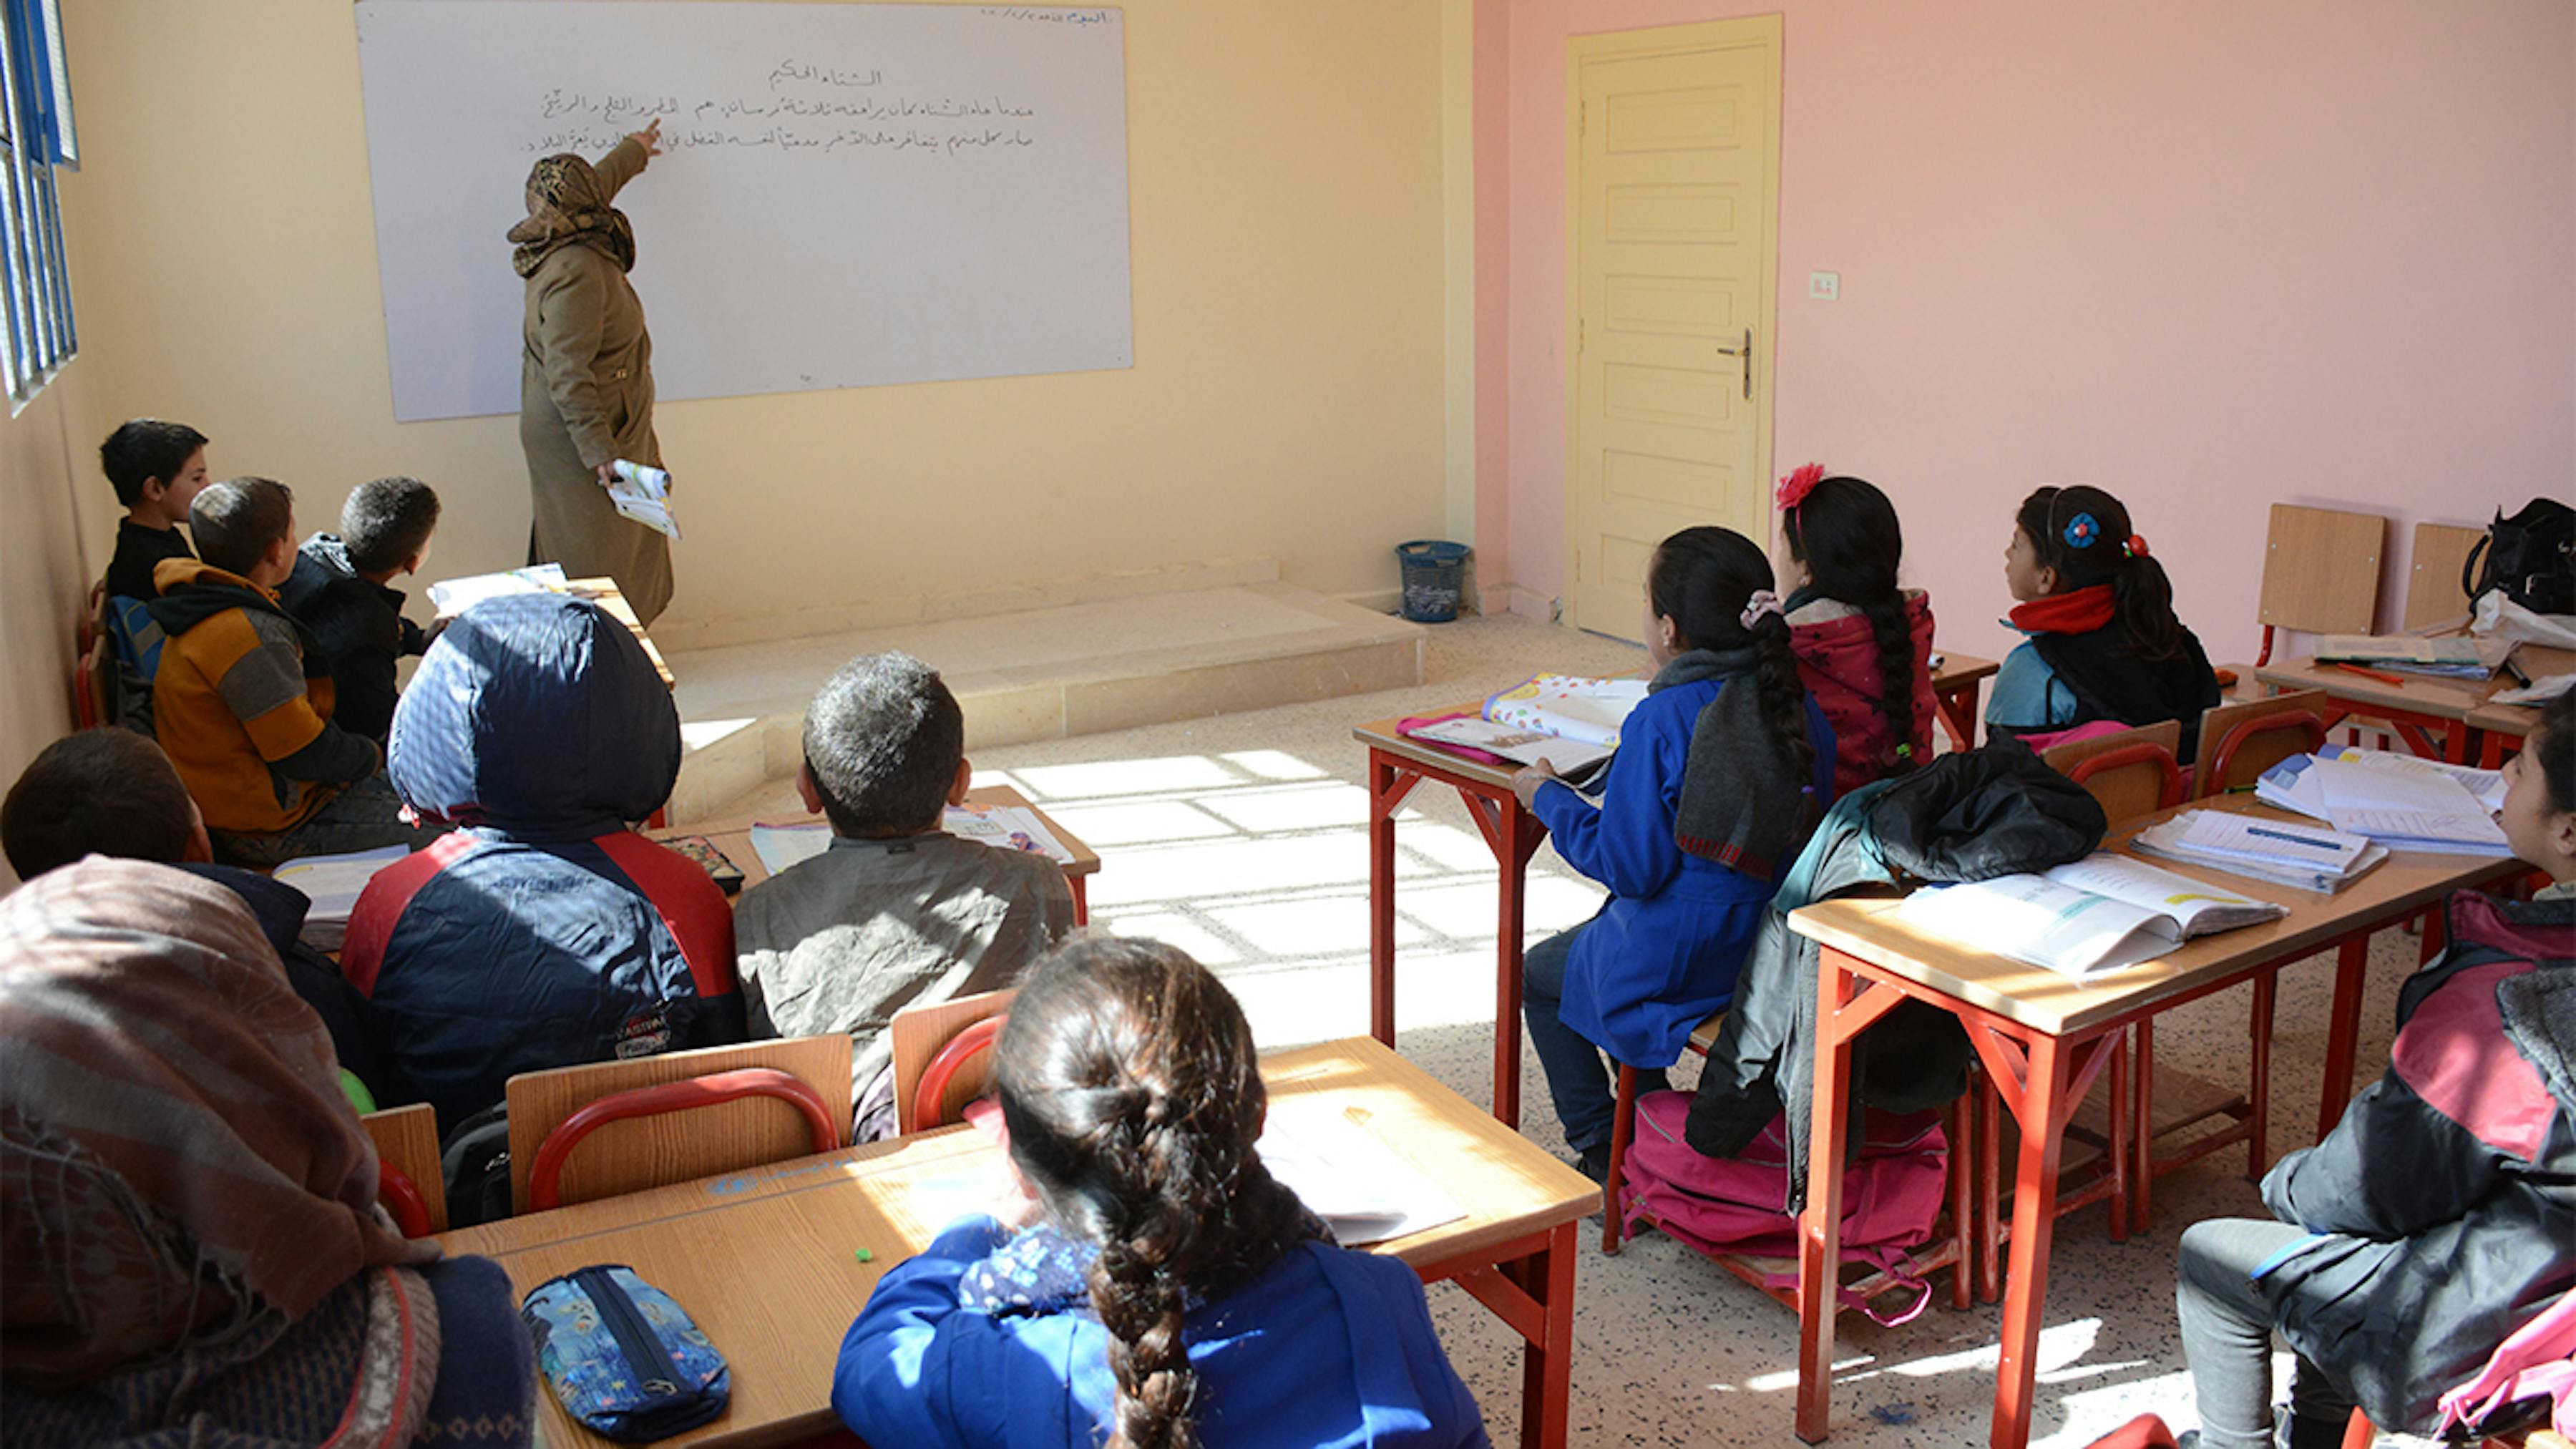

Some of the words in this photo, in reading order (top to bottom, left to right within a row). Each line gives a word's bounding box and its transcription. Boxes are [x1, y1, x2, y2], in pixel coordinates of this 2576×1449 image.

[769, 58, 819, 92] الحكيم
[821, 68, 882, 87] الشتاء
[694, 100, 716, 121] هم
